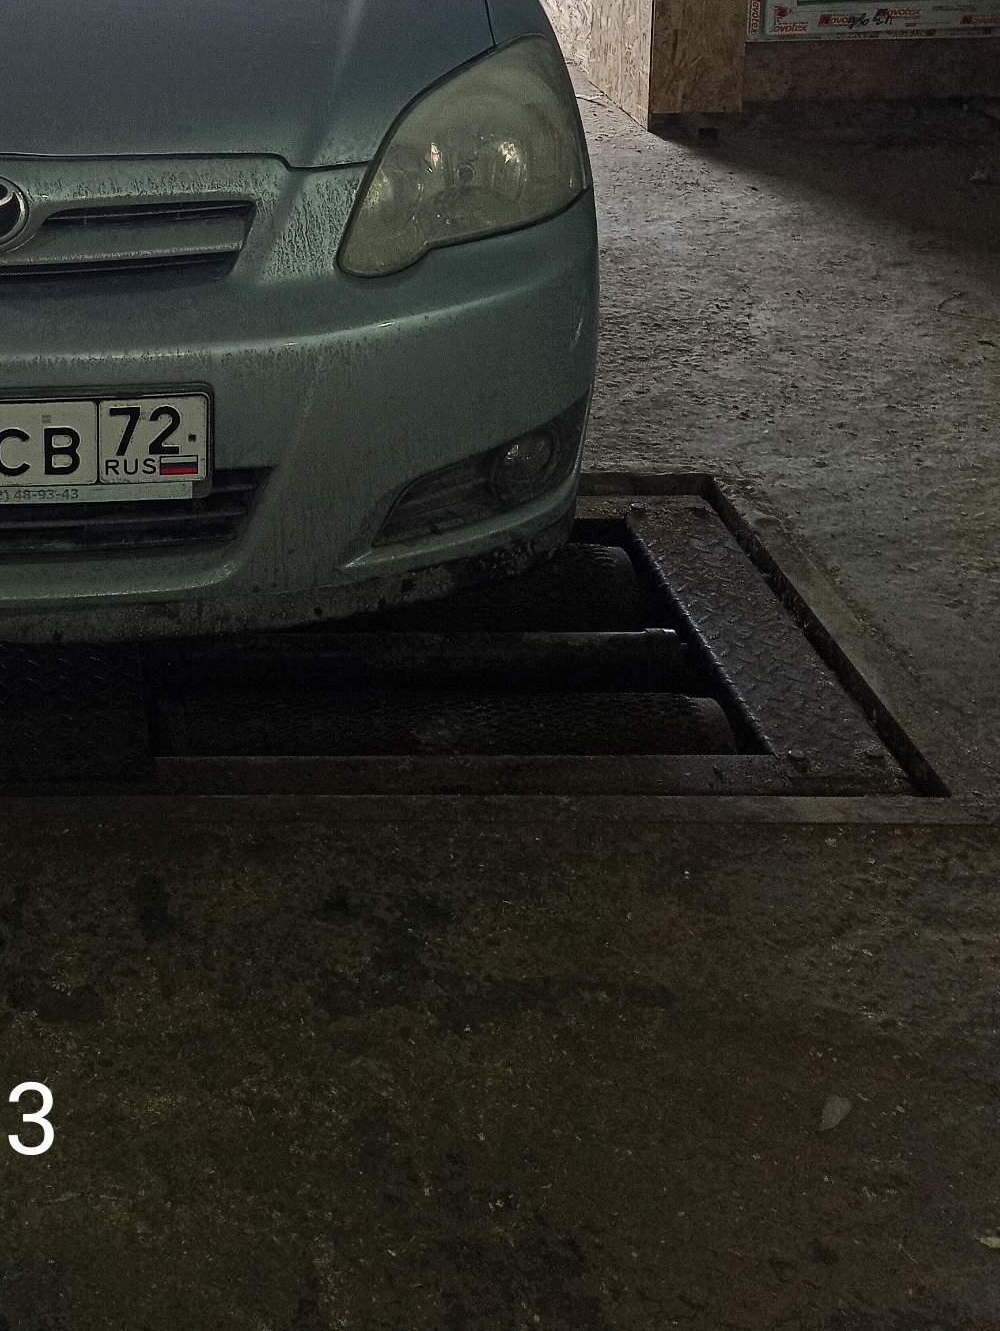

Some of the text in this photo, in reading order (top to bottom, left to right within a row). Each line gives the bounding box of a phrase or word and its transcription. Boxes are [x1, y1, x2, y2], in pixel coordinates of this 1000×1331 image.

[109, 406, 182, 456] 72
[105, 459, 157, 475] RUS
[13, 488, 79, 501] 48-93-43
